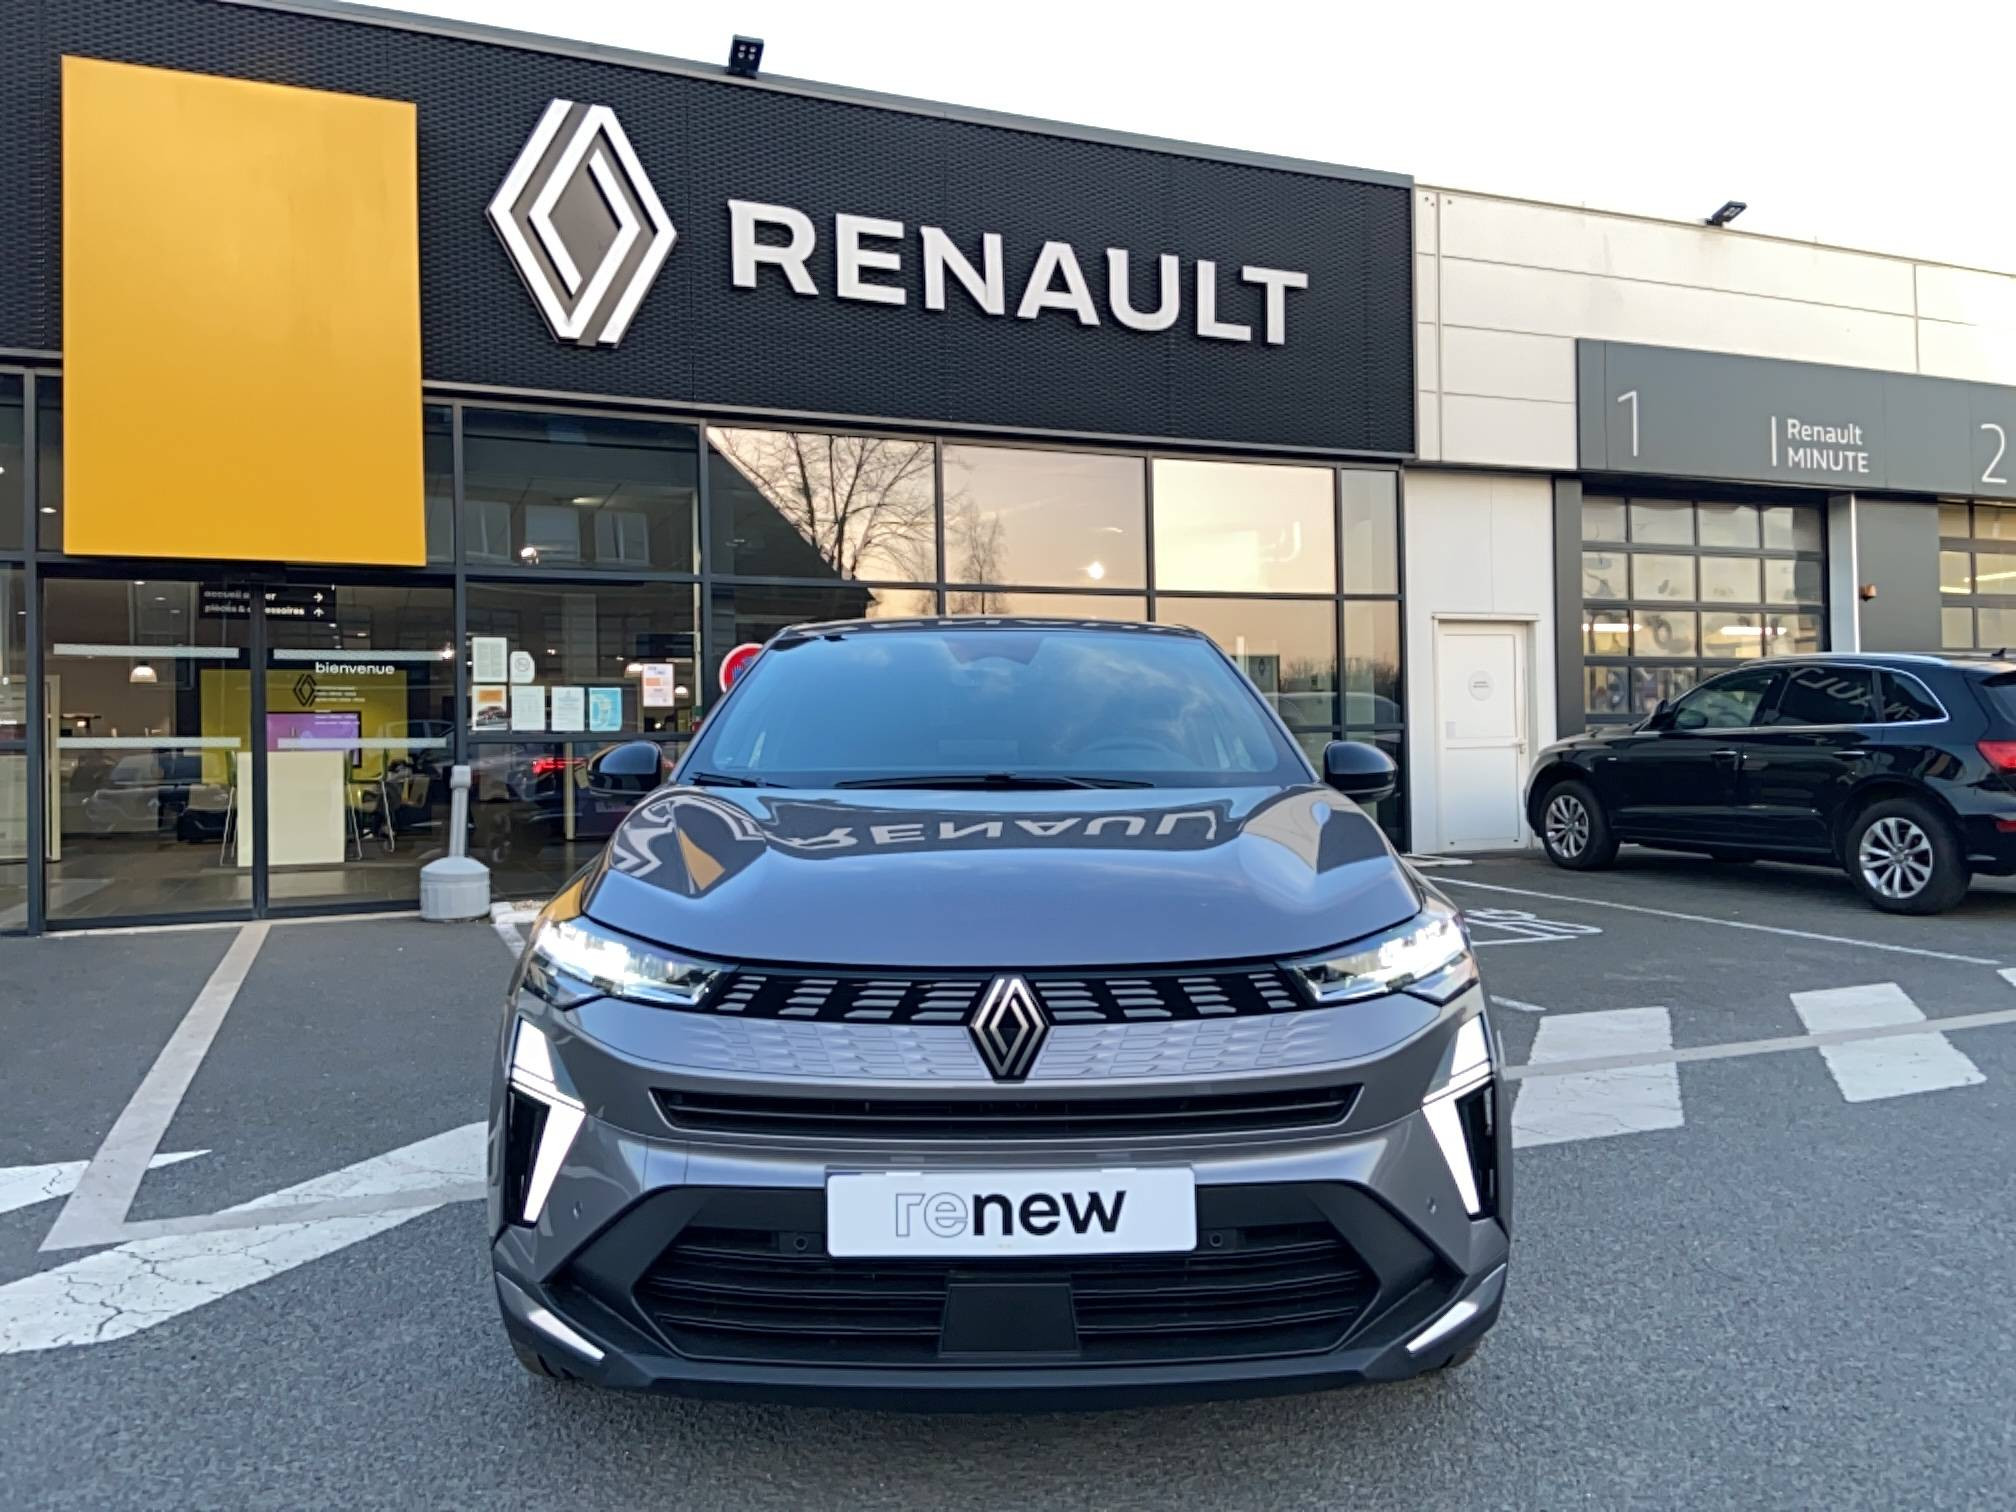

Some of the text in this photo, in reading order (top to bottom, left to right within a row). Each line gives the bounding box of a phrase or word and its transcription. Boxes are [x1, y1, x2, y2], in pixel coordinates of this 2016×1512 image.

[726, 198, 1309, 346] RENAULT
[1617, 390, 1639, 457] 1
[1786, 418, 1863, 445] Renault
[1787, 447, 1869, 474] MINUTE
[1980, 423, 2008, 484] 2
[315, 661, 395, 675] bienvenue
[895, 1190, 1127, 1239] renew
